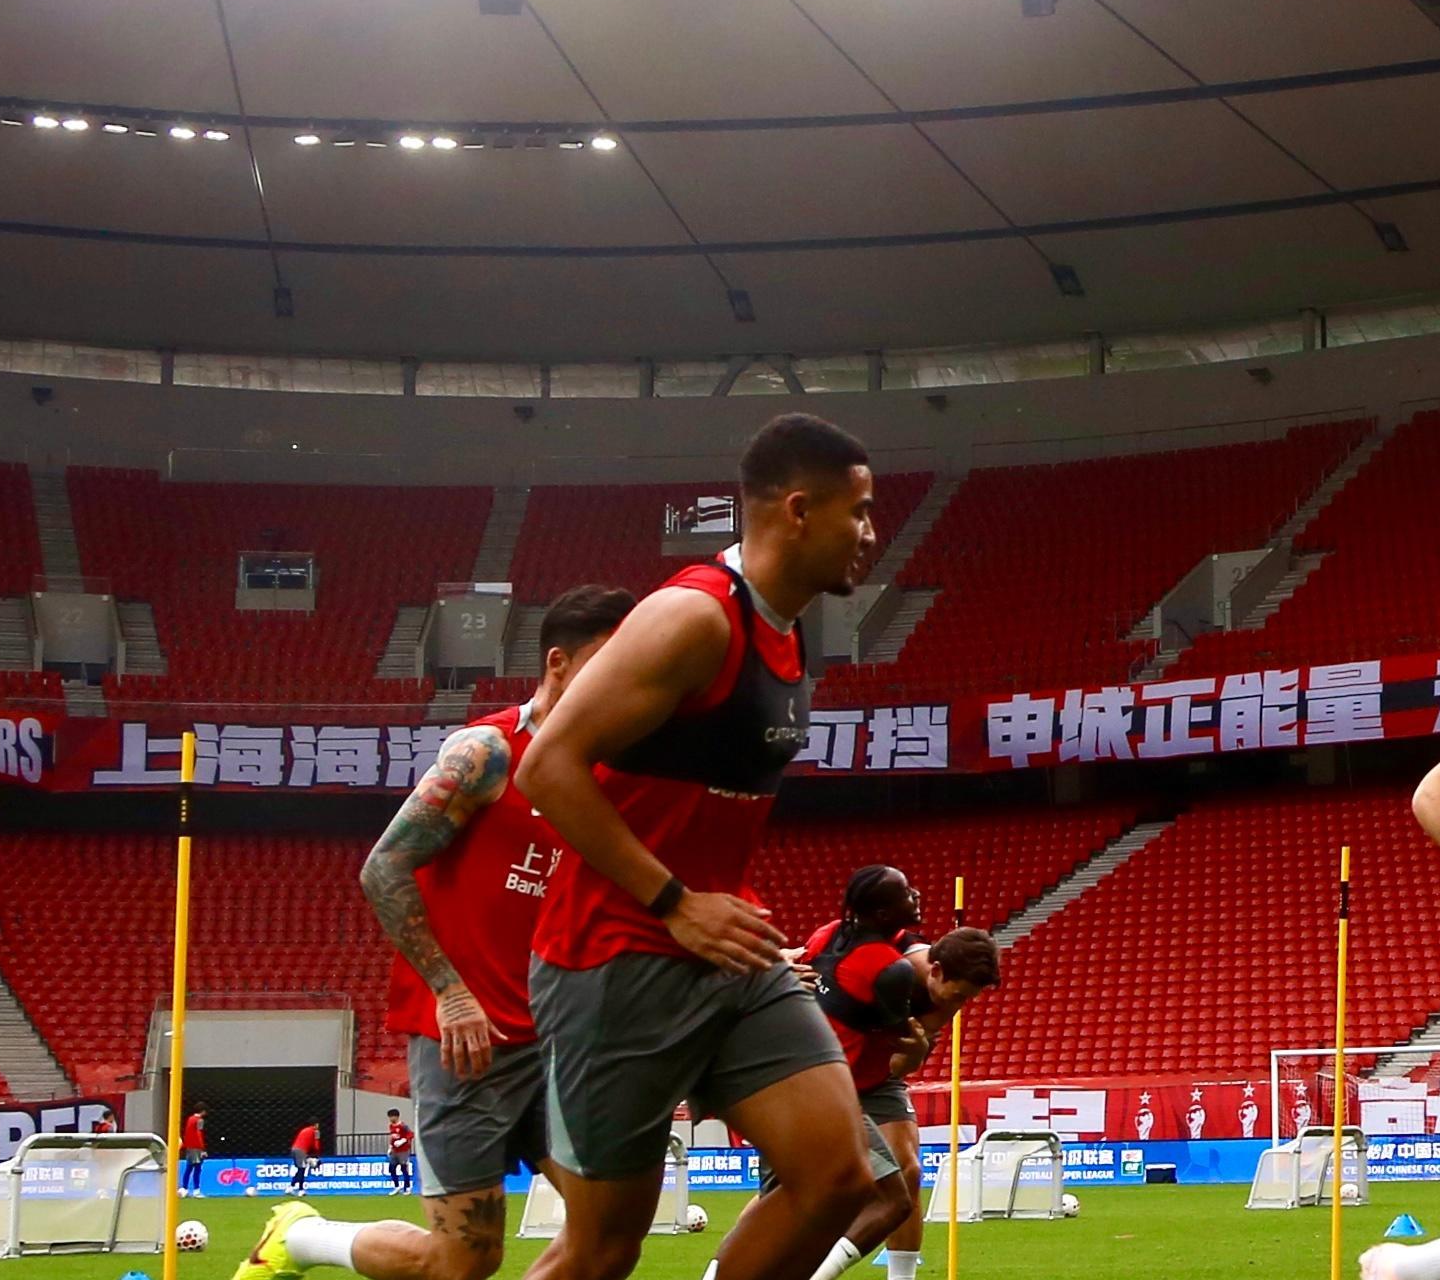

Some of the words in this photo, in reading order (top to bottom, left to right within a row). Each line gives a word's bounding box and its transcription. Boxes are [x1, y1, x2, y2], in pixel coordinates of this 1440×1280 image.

[461, 612, 487, 629] 23
[987, 660, 1384, 768] 申城正能量
[505, 873, 547, 898] Bank
[256, 1164, 289, 1177] 2026
[1083, 1170, 1114, 1179] LEAGUE
[1387, 1165, 1423, 1174] CHINESE
[361, 1181, 382, 1189] SUPER
[690, 1175, 713, 1184] SUPER
[715, 1175, 742, 1183] LEAGUE
